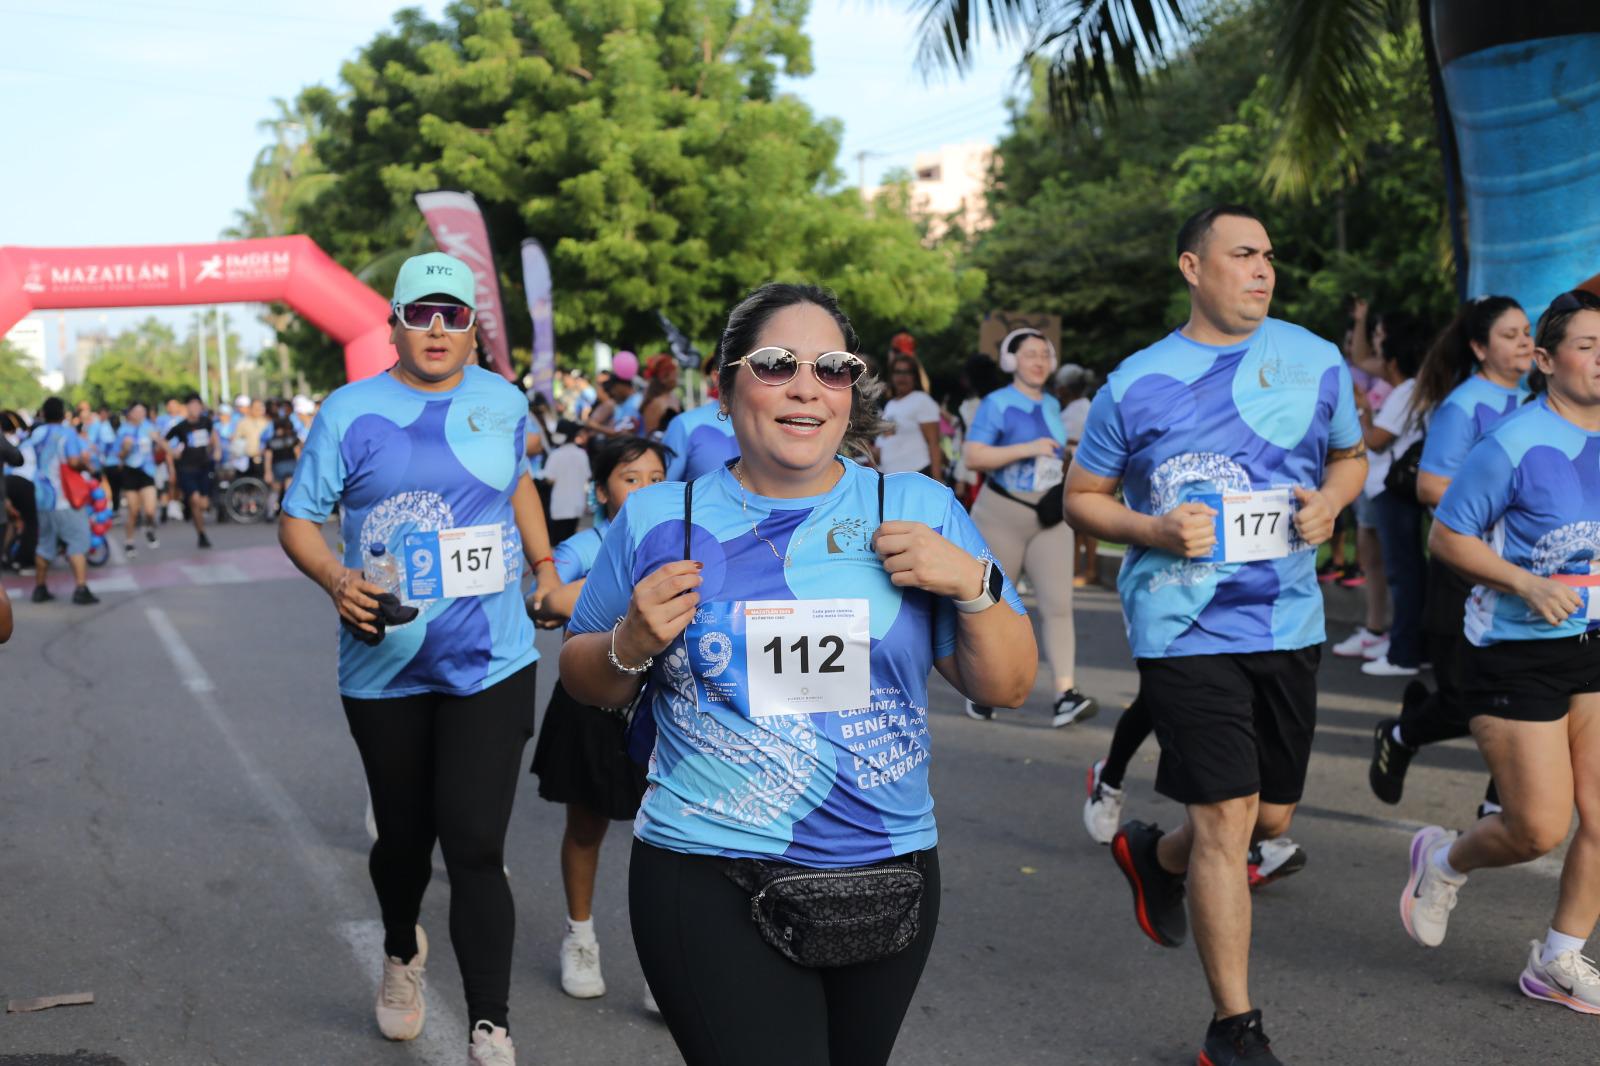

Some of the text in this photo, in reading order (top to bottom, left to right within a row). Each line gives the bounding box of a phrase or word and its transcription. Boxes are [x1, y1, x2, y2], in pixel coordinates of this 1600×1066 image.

[426, 265, 453, 276] NYC
[1234, 511, 1281, 537] 177
[411, 548, 434, 579] 9
[451, 546, 492, 573] 157
[699, 632, 732, 678] 9
[763, 635, 845, 674] 112
[857, 746, 929, 790] CEREBRAL
